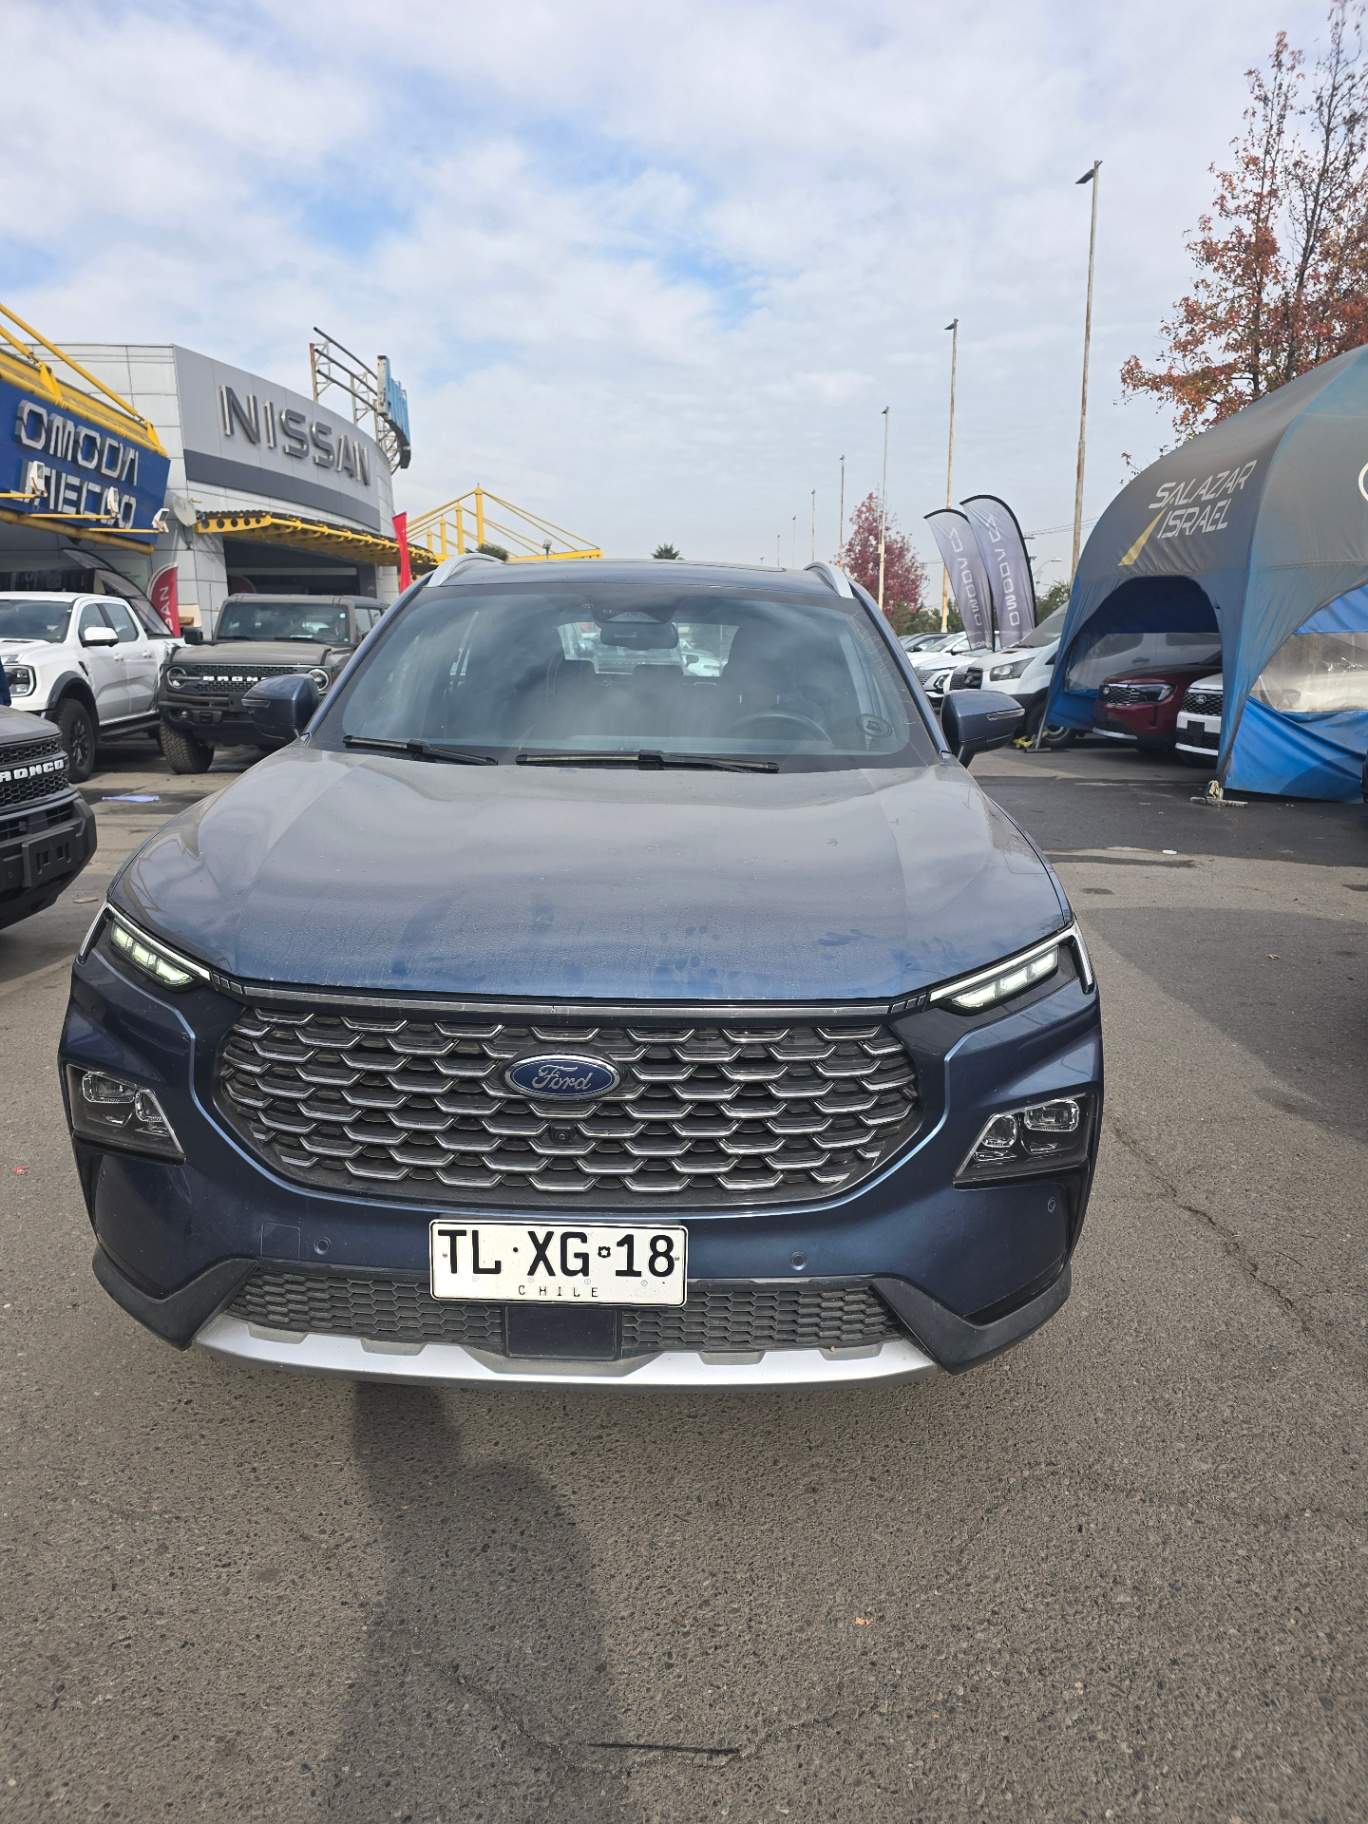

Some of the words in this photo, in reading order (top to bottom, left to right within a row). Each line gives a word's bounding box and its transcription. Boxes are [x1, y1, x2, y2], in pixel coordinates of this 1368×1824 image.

[15, 399, 139, 487] OMODA
[218, 384, 371, 485] NISSAN
[1148, 459, 1258, 509] SALAZAR
[1157, 498, 1232, 539] ISRAEL
[0, 759, 65, 782] RONCO
[531, 1064, 593, 1090] Ford
[517, 1284, 600, 1298] CHILE
